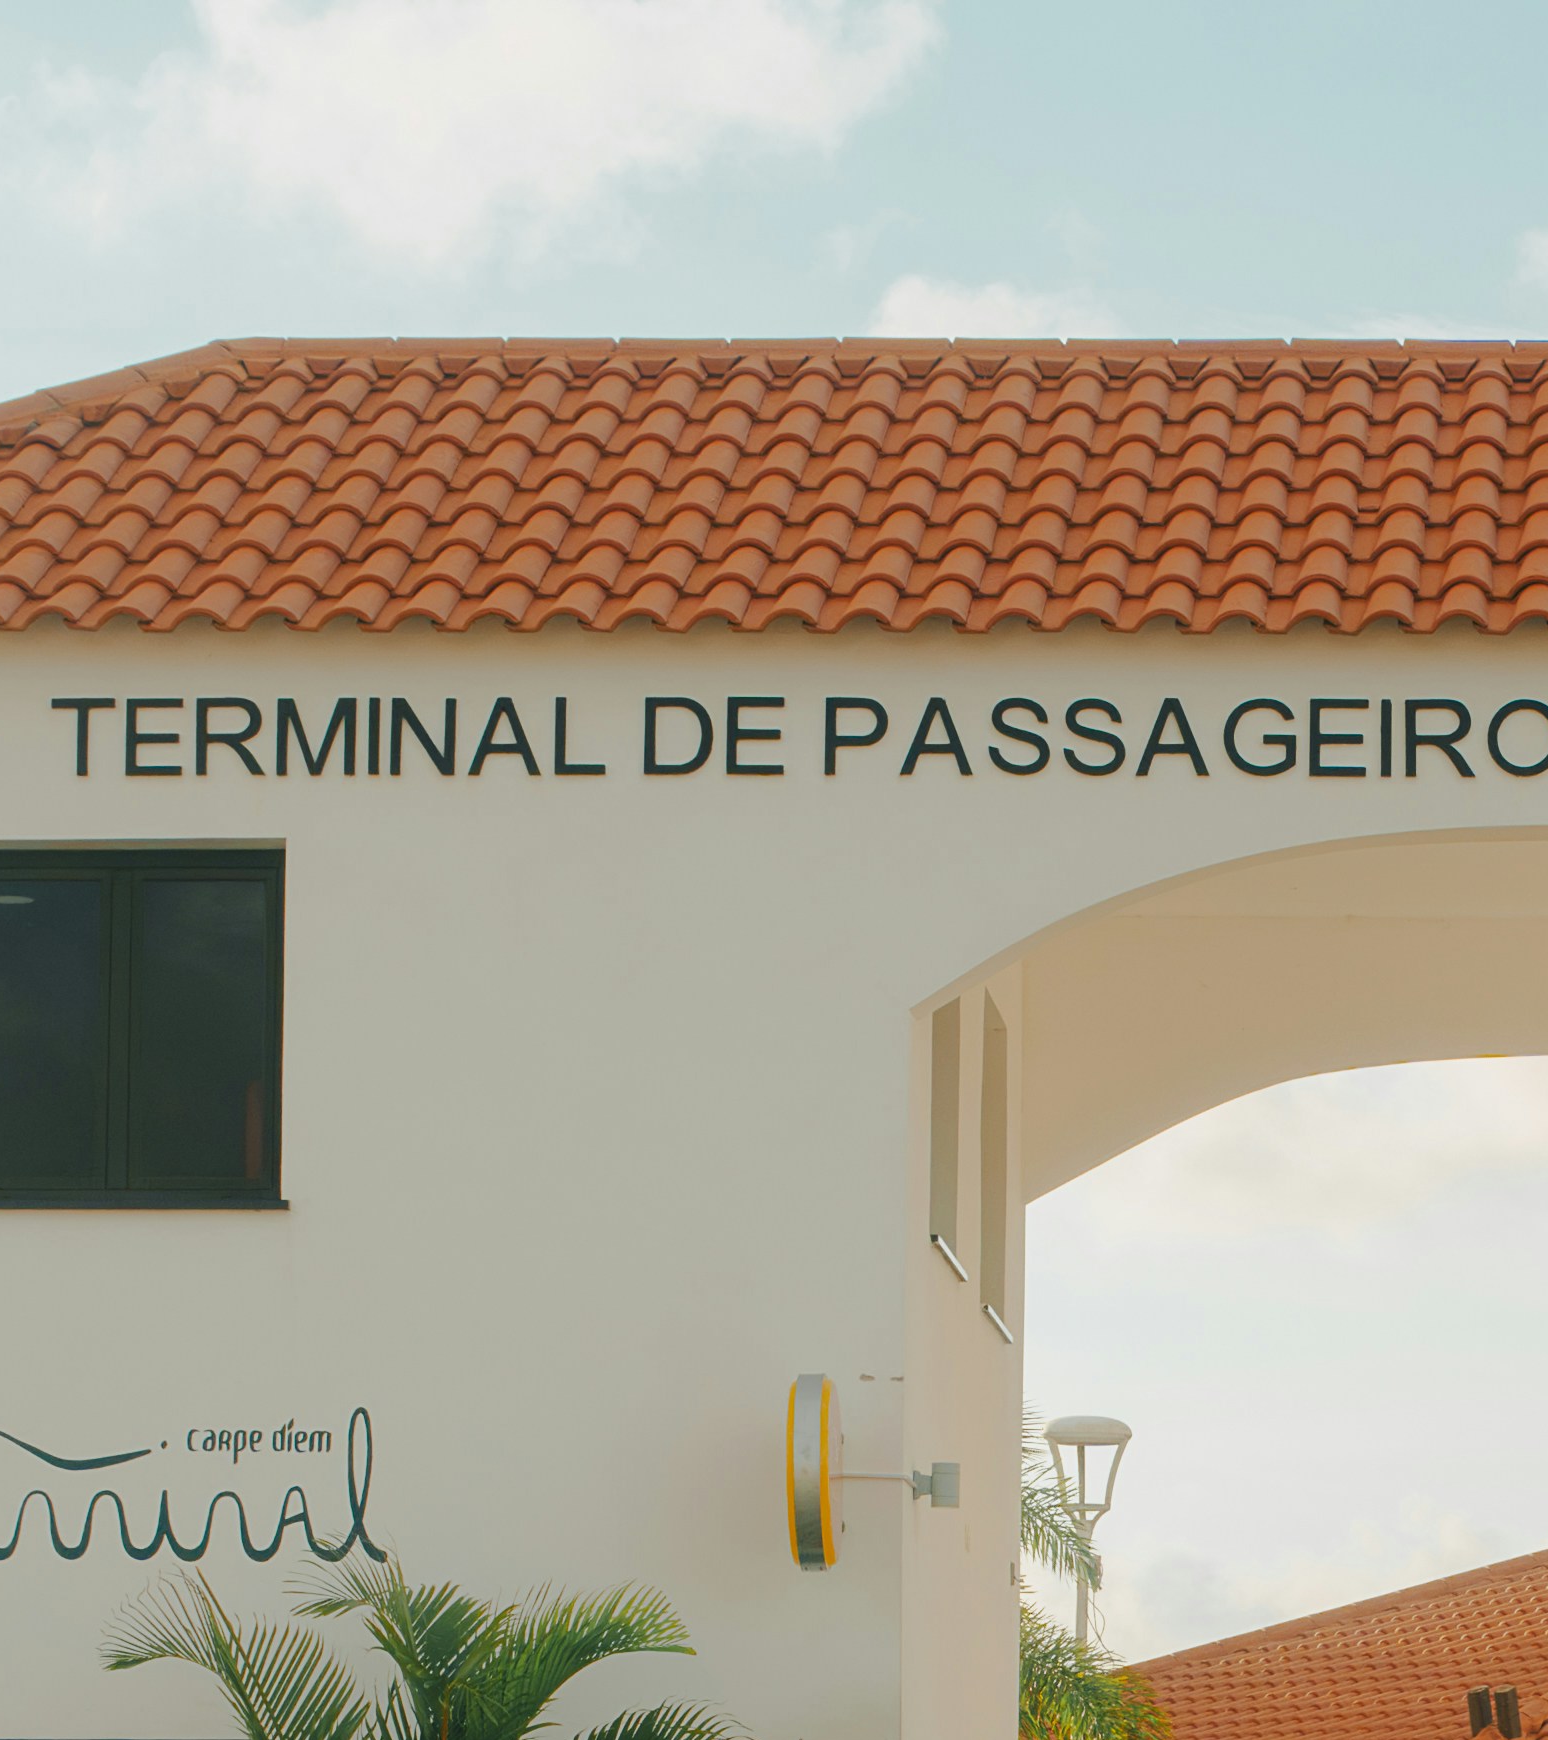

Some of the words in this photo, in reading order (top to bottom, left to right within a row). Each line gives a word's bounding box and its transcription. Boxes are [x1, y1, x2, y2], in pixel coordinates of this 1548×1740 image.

[50, 696, 607, 778] TERMINAL
[642, 695, 786, 777] DE
[271, 1417, 332, 1453] diem
